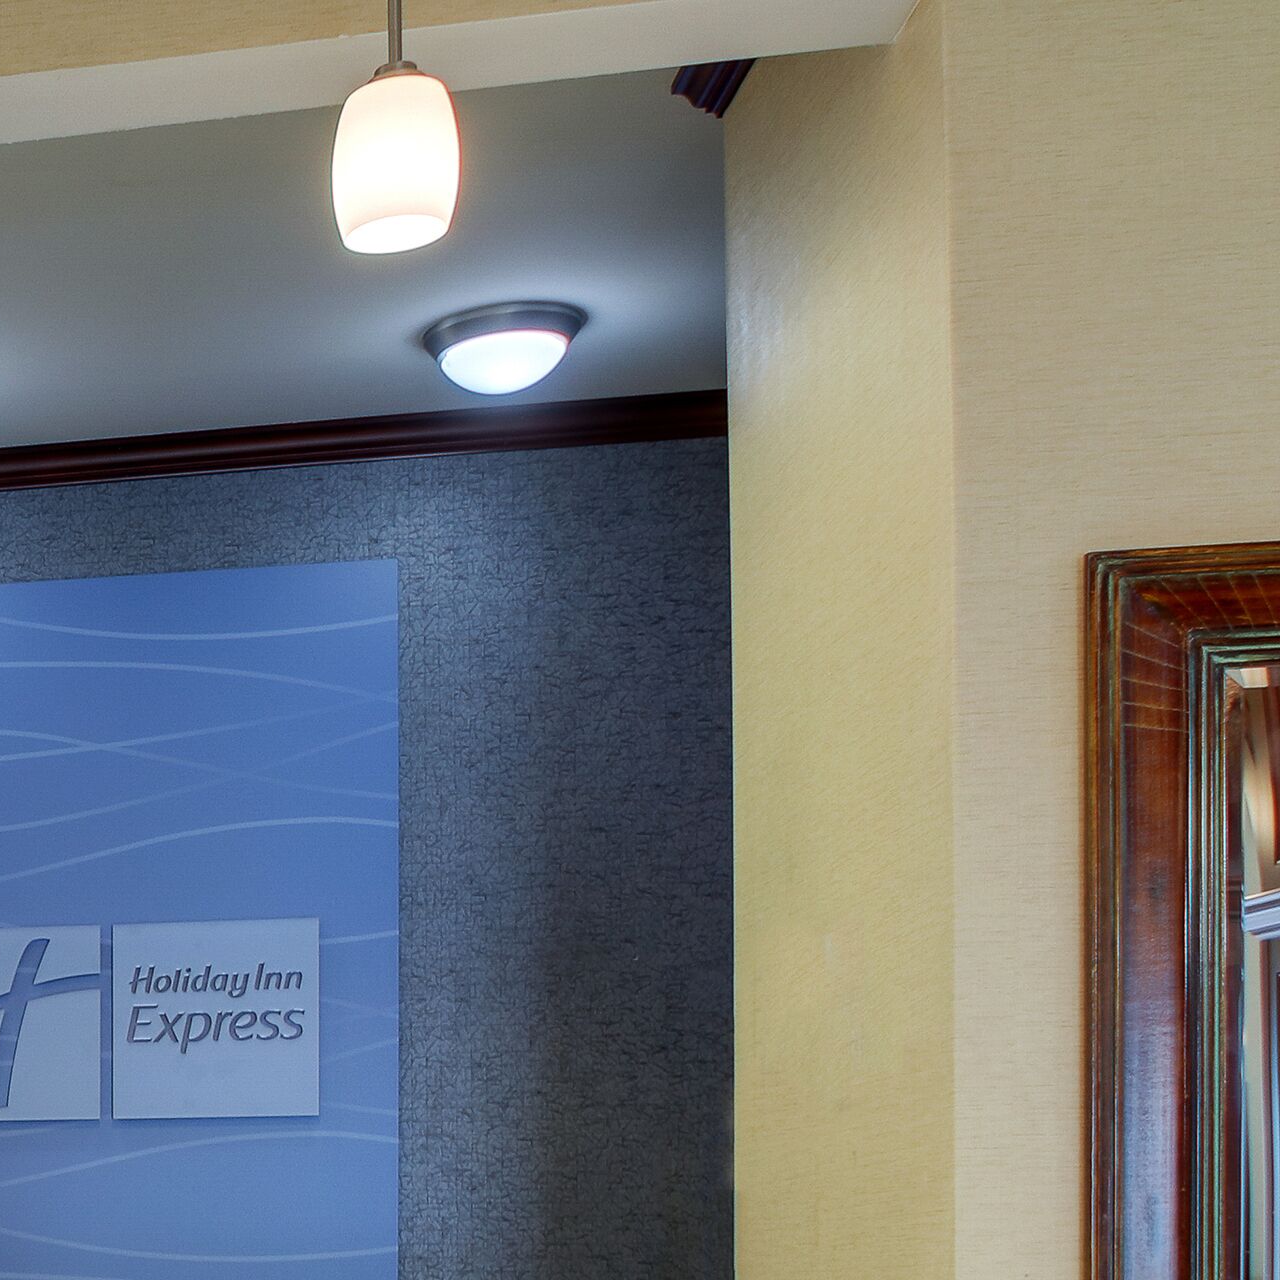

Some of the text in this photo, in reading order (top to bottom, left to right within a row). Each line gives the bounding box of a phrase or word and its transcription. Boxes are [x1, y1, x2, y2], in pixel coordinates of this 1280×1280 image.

[129, 962, 303, 998] Holiday Inn
[126, 1003, 305, 1054] Express
